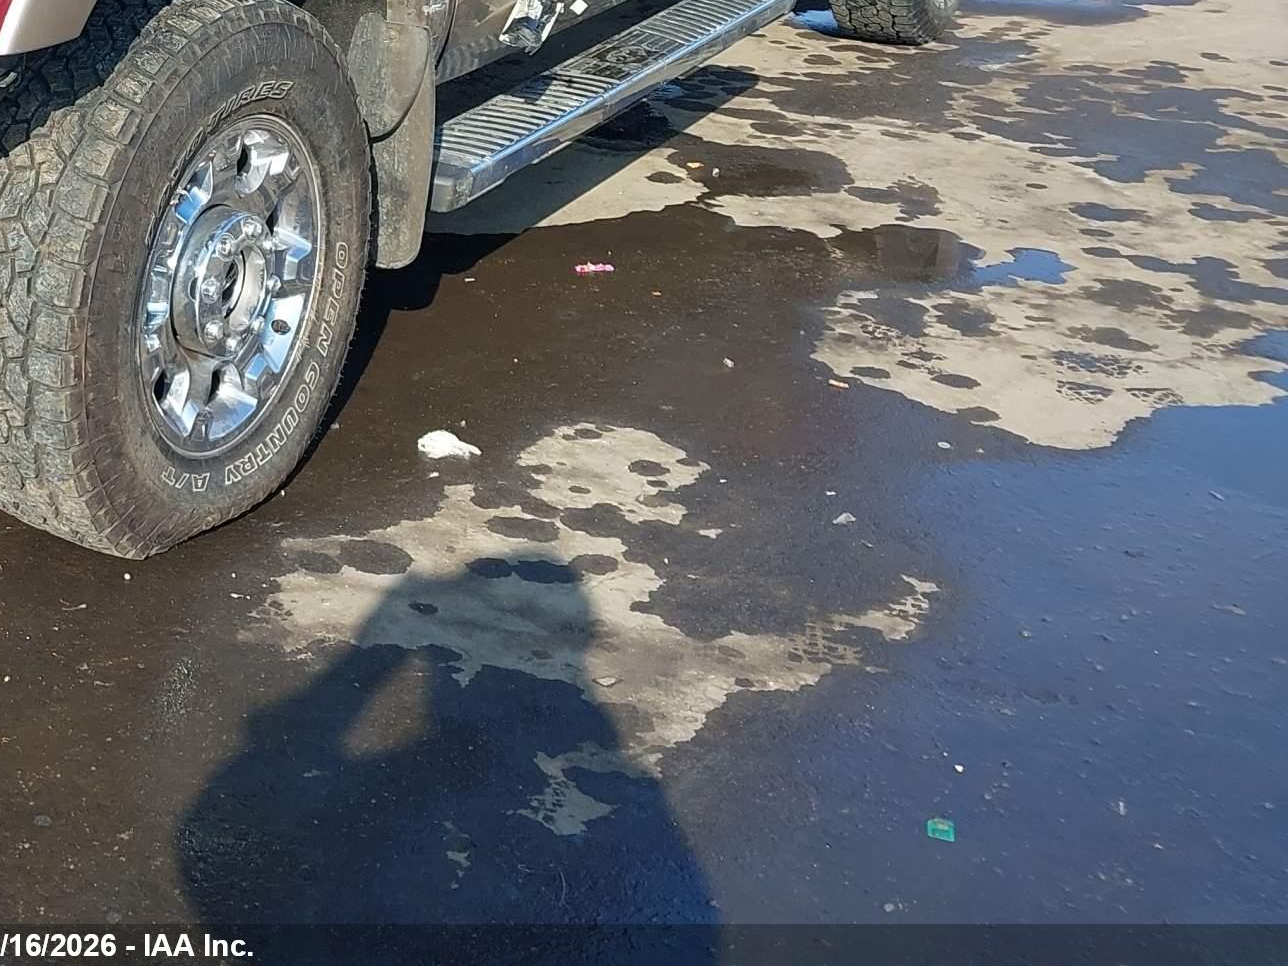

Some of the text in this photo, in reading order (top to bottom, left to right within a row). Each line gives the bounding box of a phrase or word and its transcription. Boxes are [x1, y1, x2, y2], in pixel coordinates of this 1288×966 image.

[207, 80, 294, 133] TIRES
[160, 241, 349, 492] OPEN COUNTRY A/T
